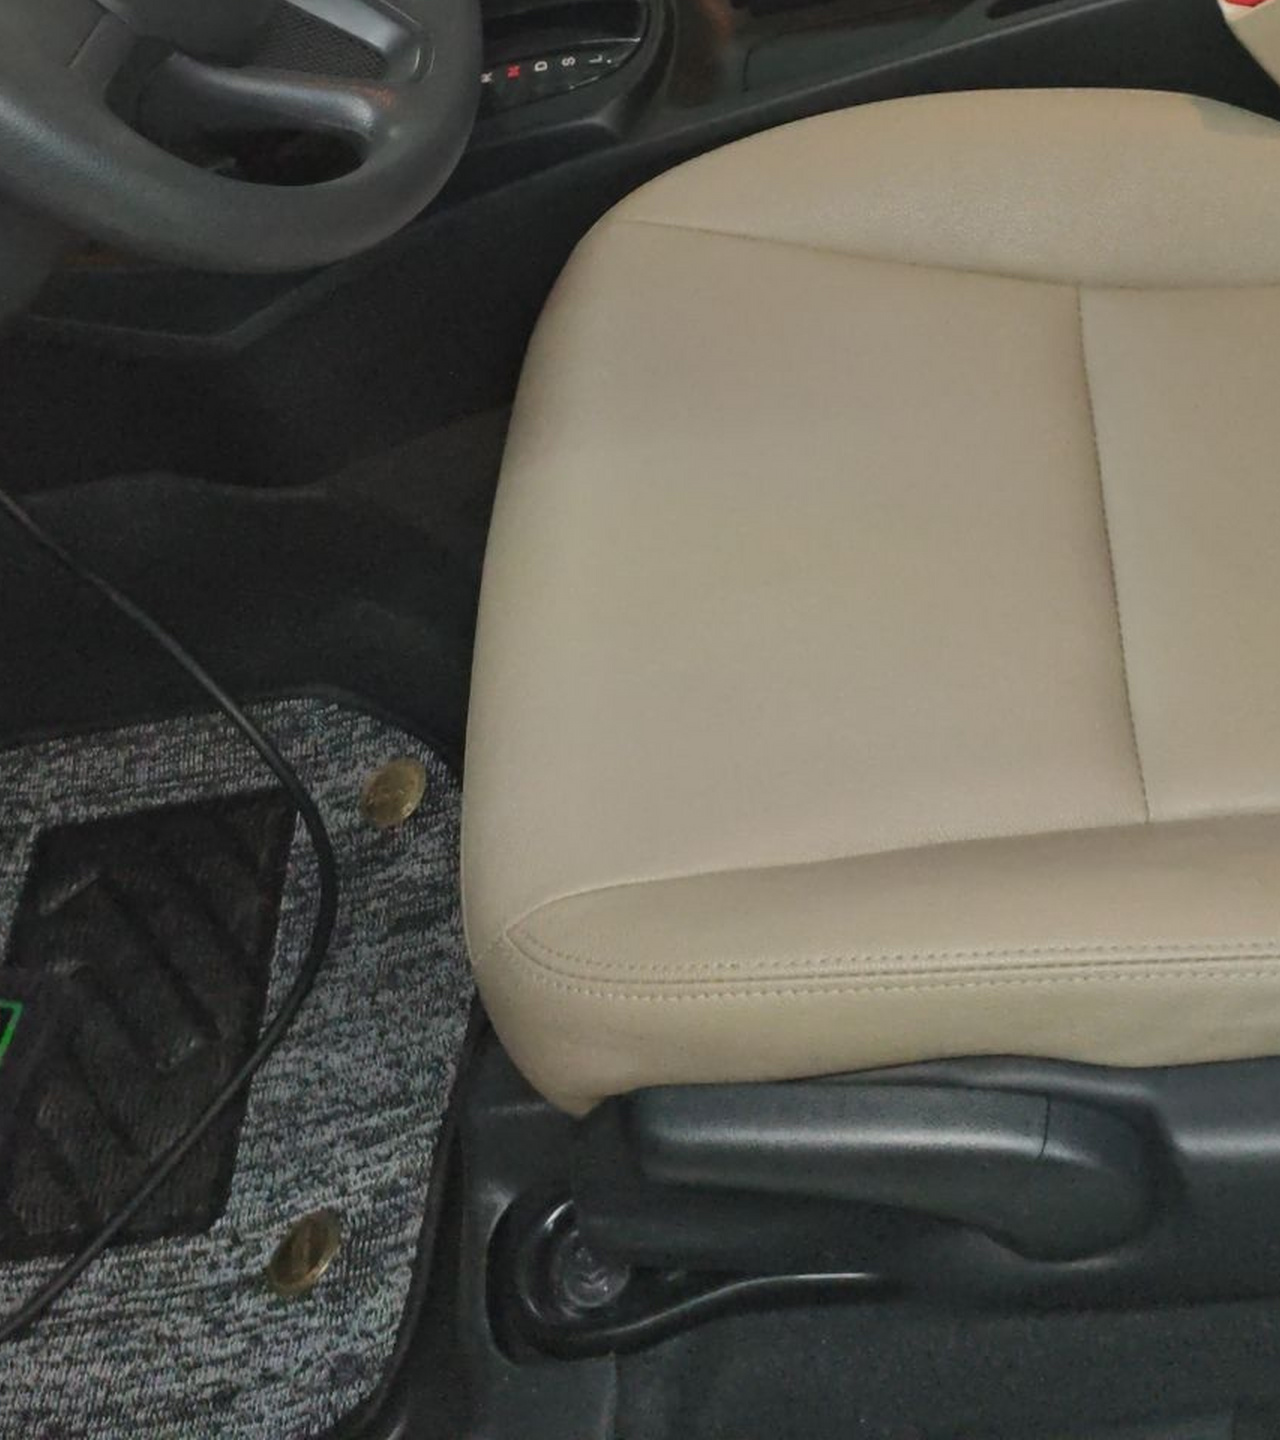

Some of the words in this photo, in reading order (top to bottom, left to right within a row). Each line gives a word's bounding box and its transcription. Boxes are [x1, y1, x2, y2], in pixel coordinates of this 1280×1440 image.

[534, 61, 548, 72] D
[561, 56, 575, 67] S
[589, 54, 603, 63] L
